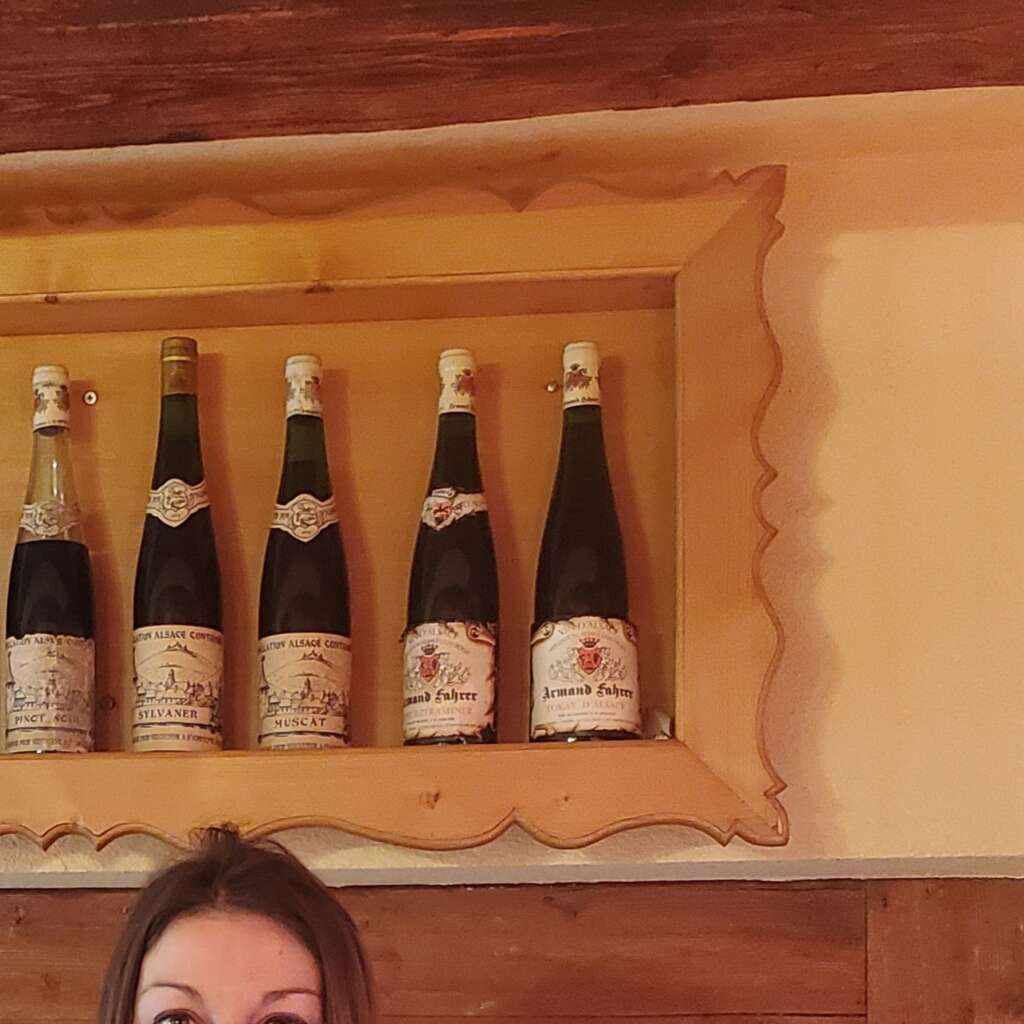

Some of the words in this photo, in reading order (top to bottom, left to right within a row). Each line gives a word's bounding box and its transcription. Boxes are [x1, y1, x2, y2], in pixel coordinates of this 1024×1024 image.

[154, 630, 186, 640] ALSACE
[288, 639, 321, 649] ALSACE
[542, 684, 592, 701] Armand
[137, 708, 198, 720] SYLVANER
[274, 718, 327, 728] MUSCAT
